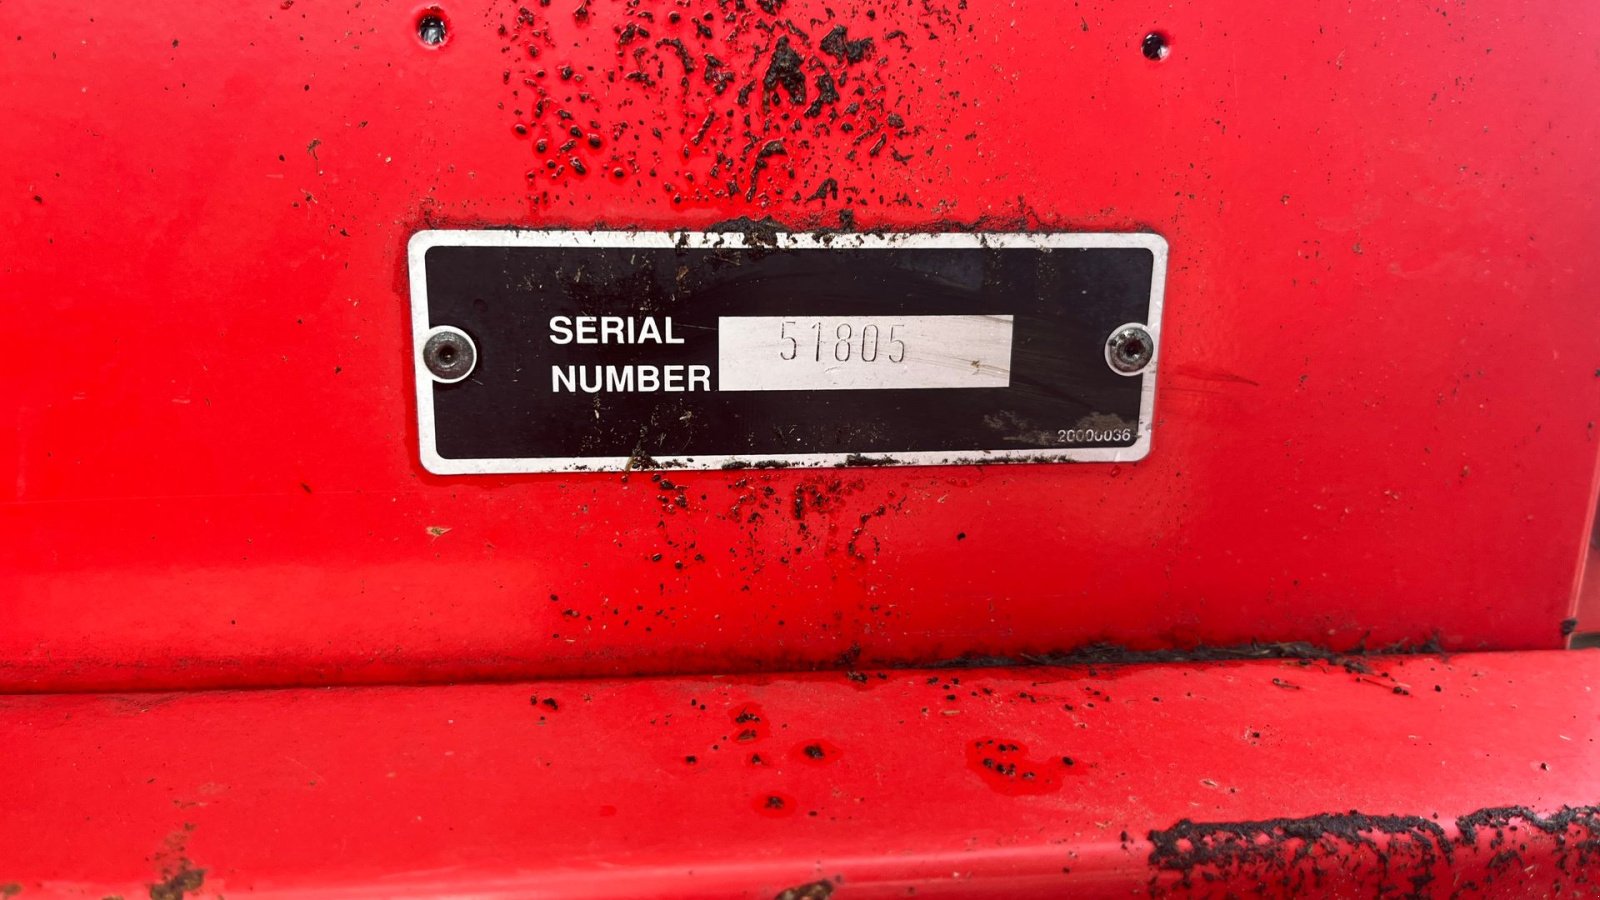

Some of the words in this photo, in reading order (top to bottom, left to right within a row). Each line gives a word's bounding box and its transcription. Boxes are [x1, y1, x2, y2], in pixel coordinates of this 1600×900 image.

[549, 315, 685, 345] SERIAL
[780, 321, 905, 363] 51805
[551, 365, 711, 393] NUMBER
[1057, 428, 1131, 442] 20000036
